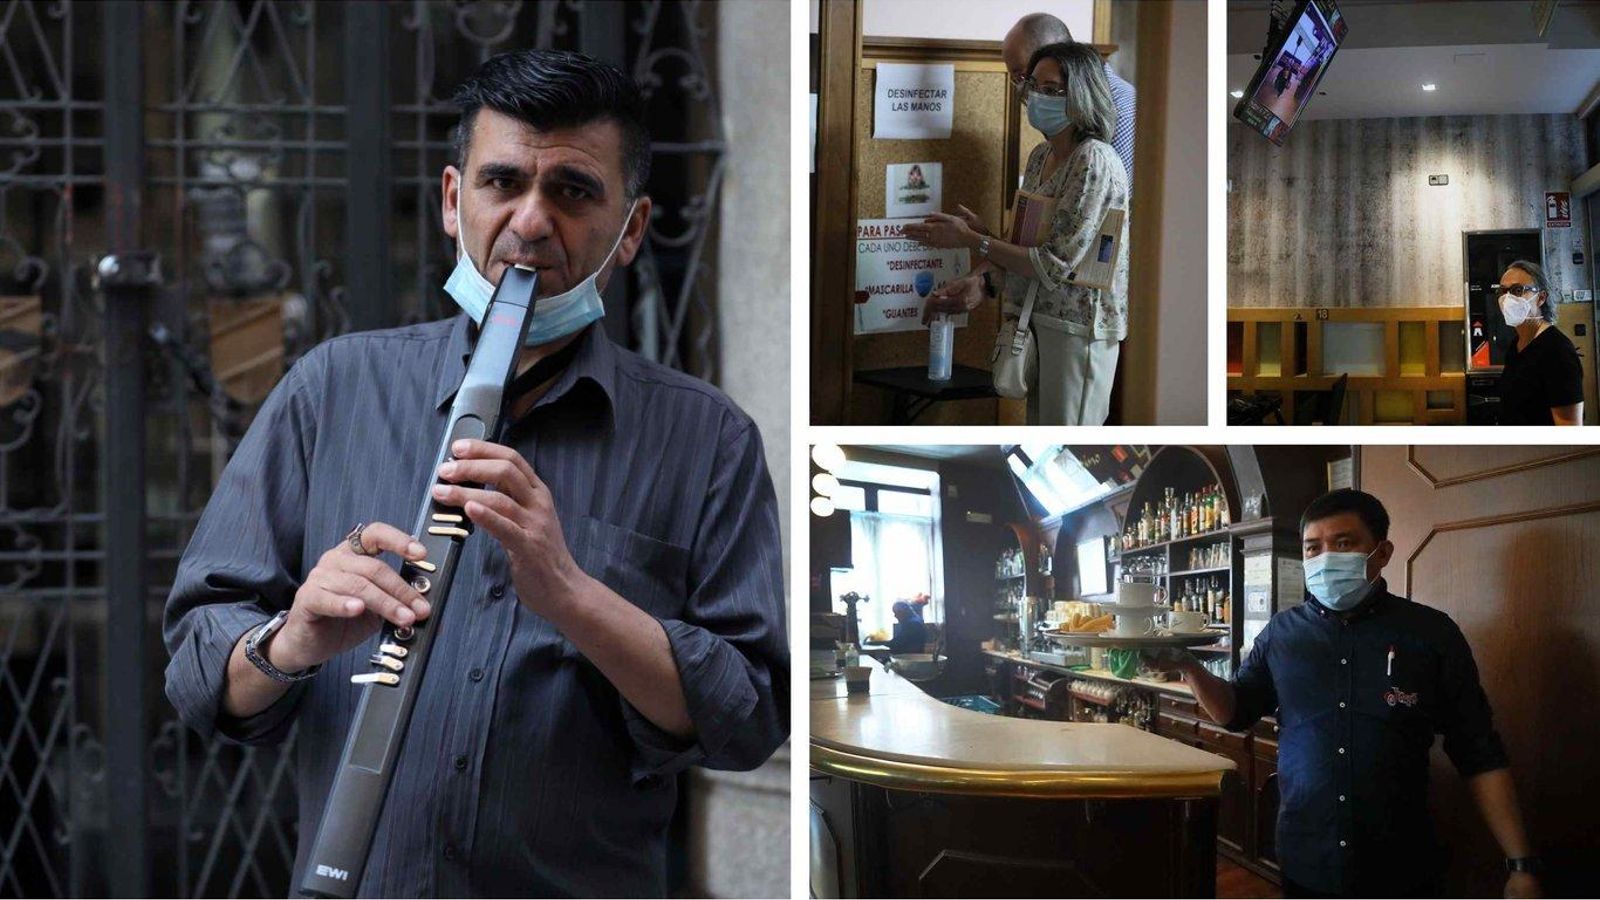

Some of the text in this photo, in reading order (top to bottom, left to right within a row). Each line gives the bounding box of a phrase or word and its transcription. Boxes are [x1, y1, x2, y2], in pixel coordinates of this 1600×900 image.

[887, 89, 947, 99] DESINFECTAR
[892, 102, 942, 111] LAS MANOS
[857, 225, 906, 237] PARA PAS
[858, 242, 881, 253] CADA
[884, 241, 901, 253] UNO
[1317, 309, 1328, 319] 18
[315, 864, 349, 881] EWI
